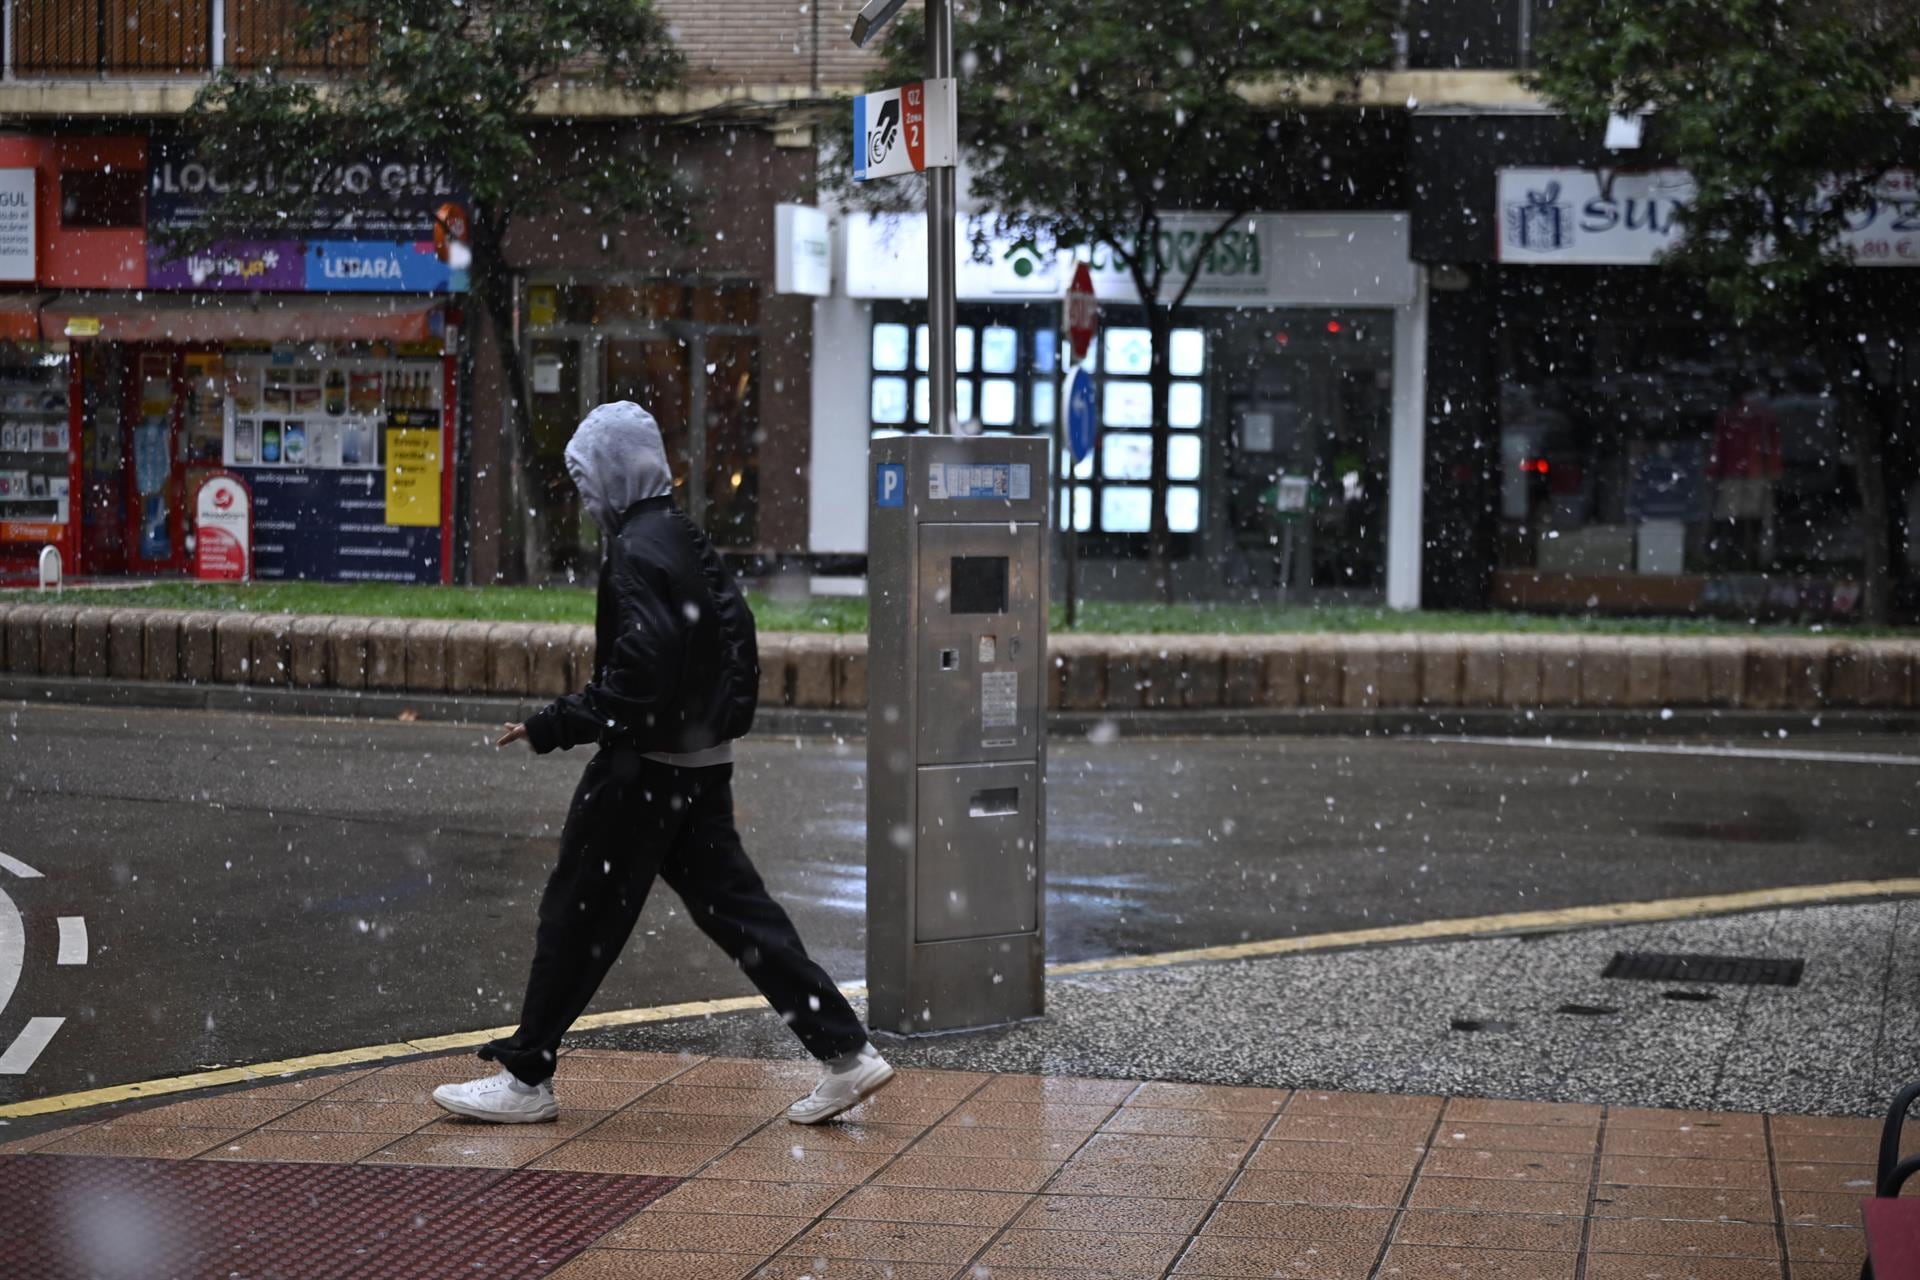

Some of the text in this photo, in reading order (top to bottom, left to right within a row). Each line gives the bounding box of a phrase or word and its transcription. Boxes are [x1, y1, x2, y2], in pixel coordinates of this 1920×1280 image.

[911, 125, 919, 147] 2
[324, 258, 402, 278] LEBARA
[884, 470, 898, 500] P
